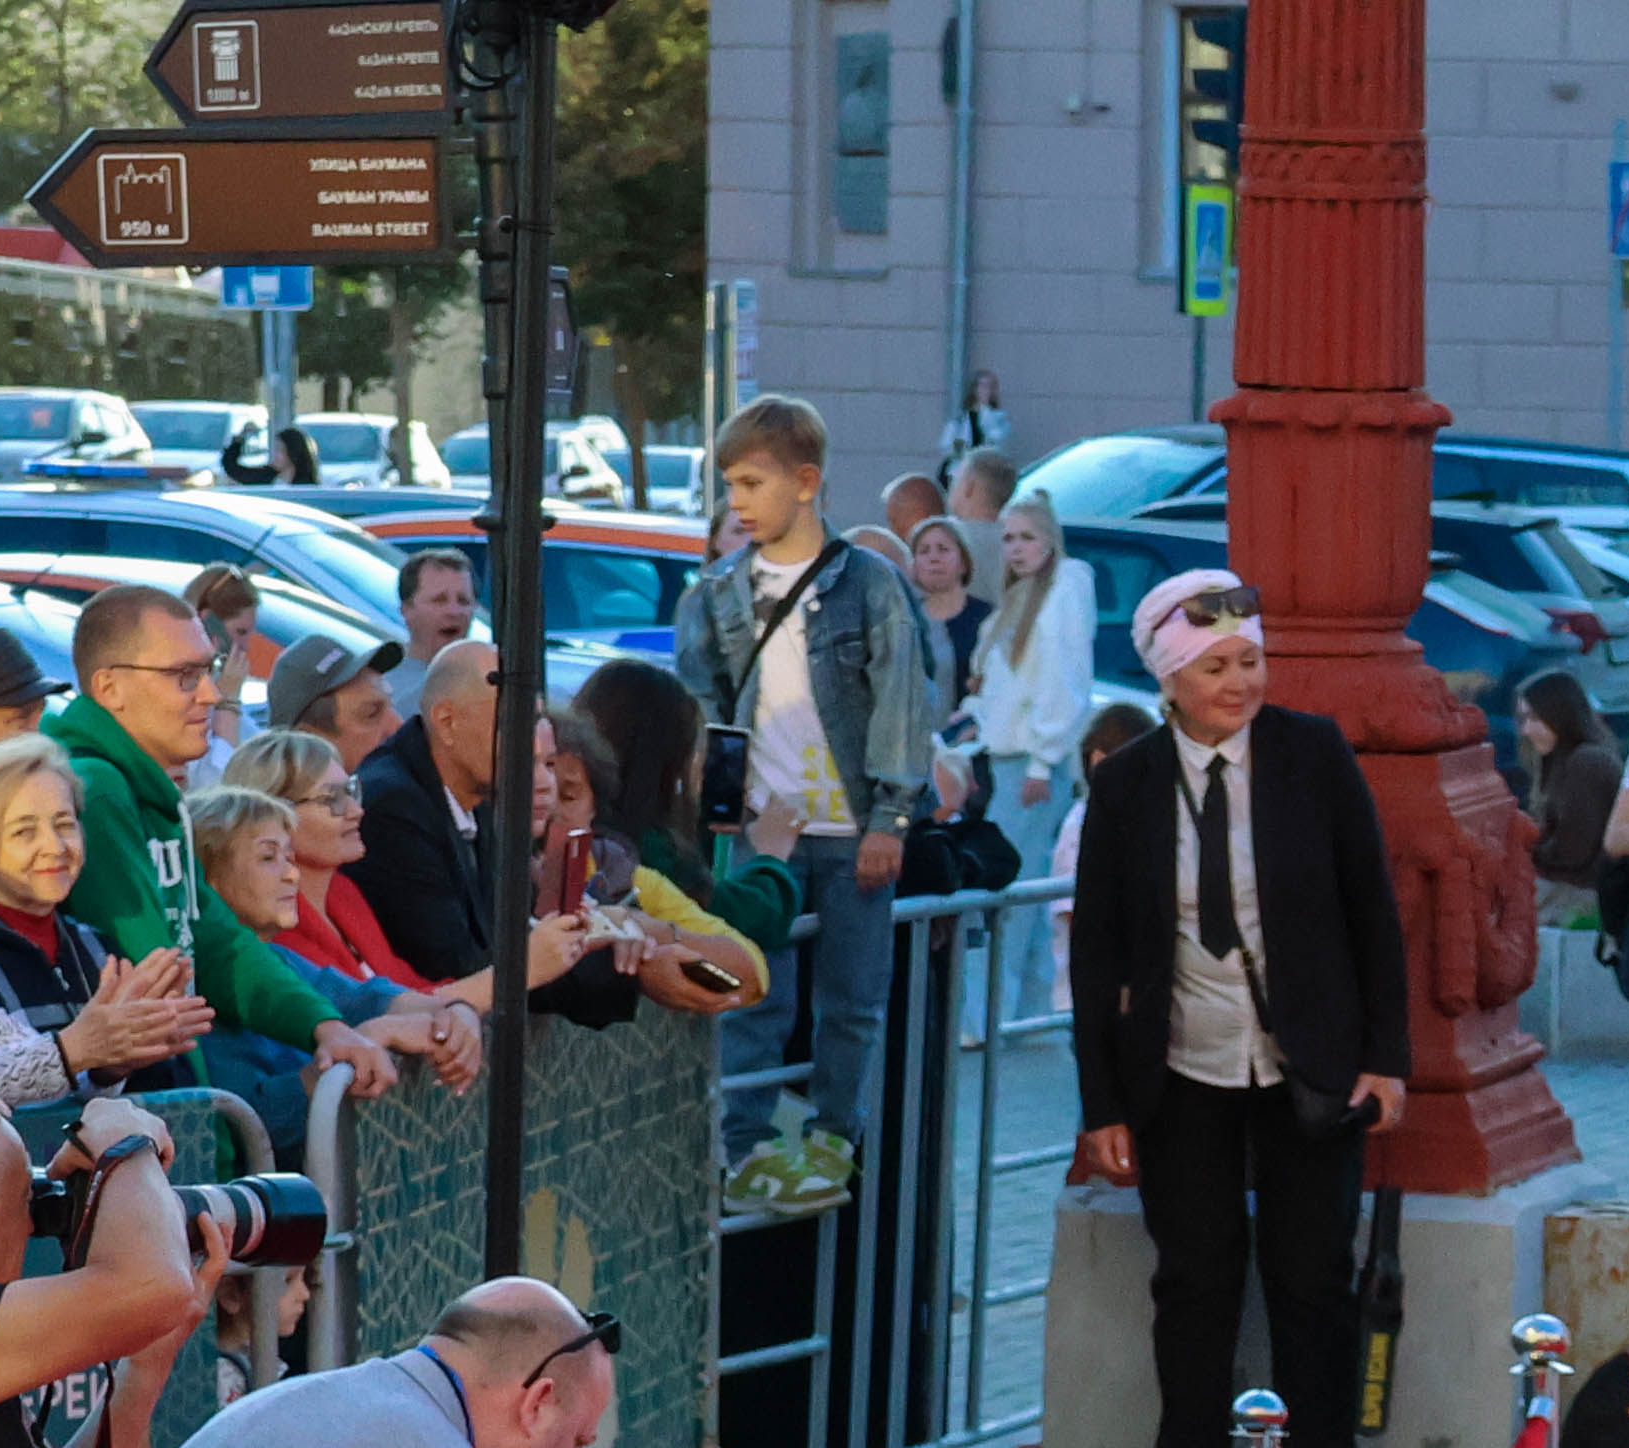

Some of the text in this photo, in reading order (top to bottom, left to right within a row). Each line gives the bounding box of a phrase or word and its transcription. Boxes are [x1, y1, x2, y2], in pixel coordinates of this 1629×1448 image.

[309, 158, 427, 172] УЛИЦА БАУМАНА
[318, 190, 429, 204] БАУМАН УРАМЫ
[312, 221, 429, 237] BAUMAN STREET
